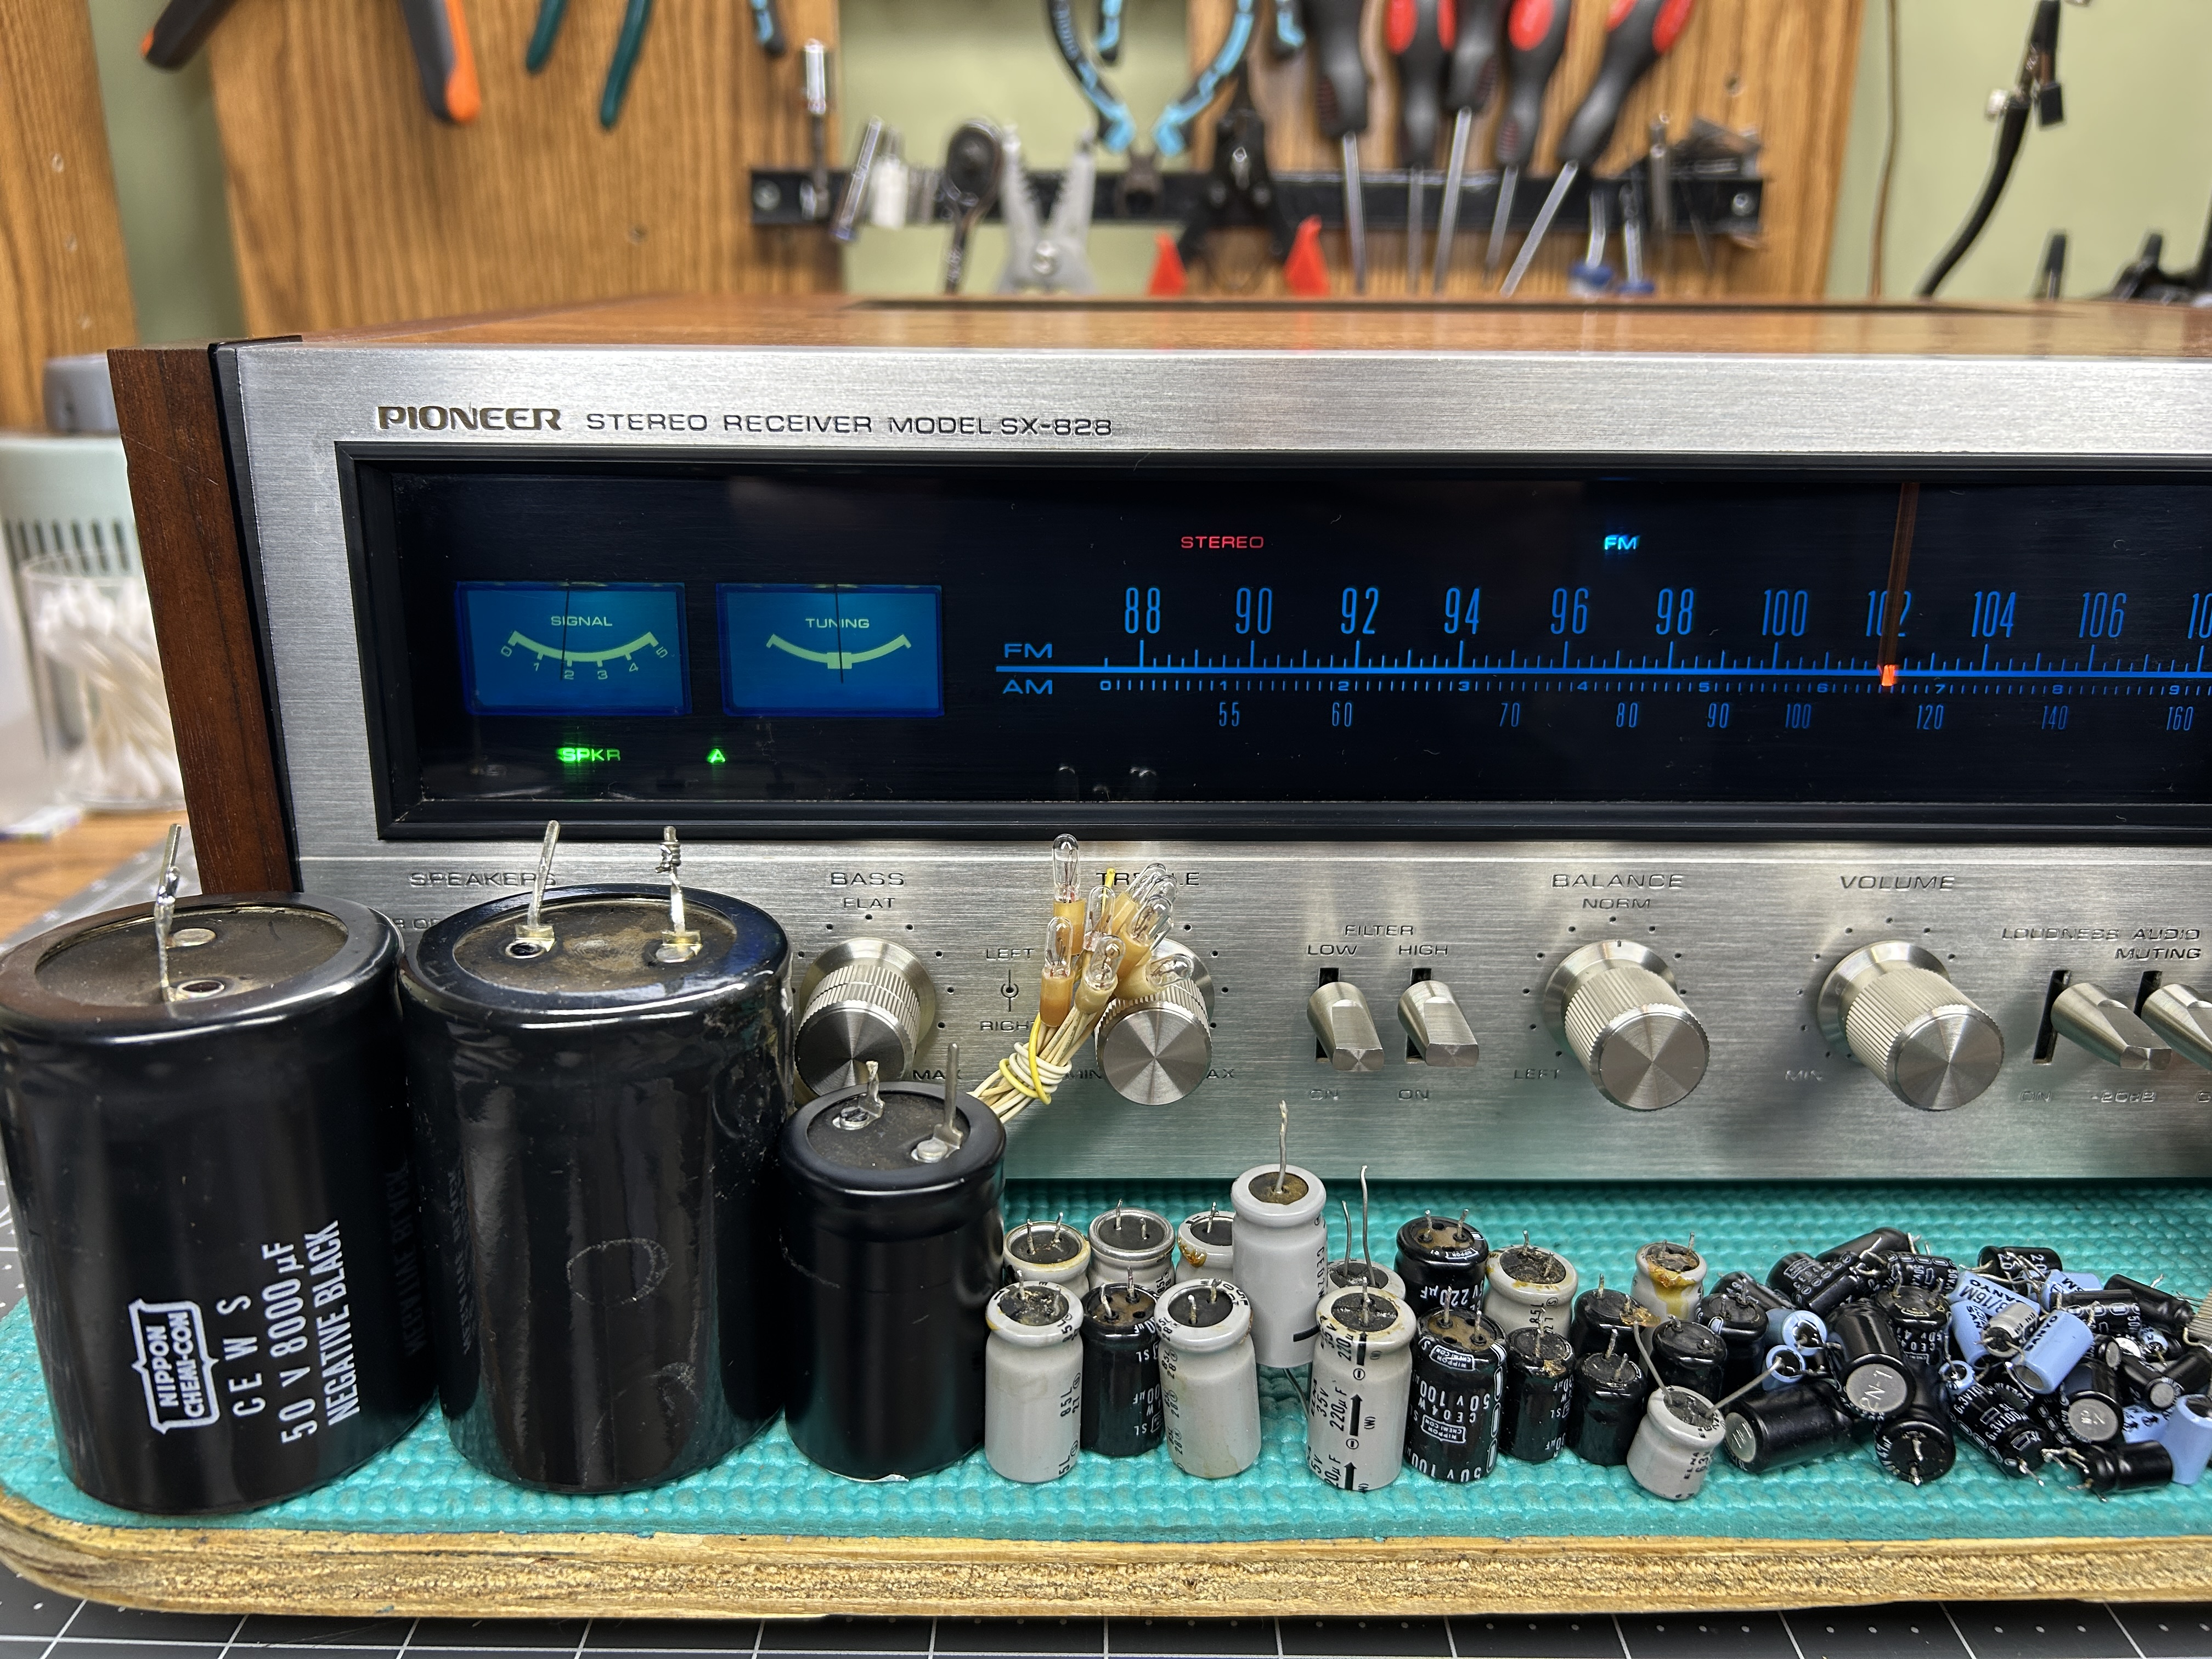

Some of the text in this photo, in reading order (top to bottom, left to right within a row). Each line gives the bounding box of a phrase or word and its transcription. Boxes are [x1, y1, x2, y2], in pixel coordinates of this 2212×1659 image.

[377, 406, 562, 431] PIONEER
[587, 413, 1113, 437] STEREO RECEIVER MODEL SX-828
[1181, 535, 1264, 549] STEREO
[1604, 534, 1640, 550] FM
[1124, 586, 1160, 634] 88
[1235, 587, 1272, 634] 90
[1340, 587, 1379, 634] 92
[1443, 587, 1480, 635] 94
[1550, 588, 1589, 635] 96
[1655, 588, 1695, 635] 98
[1762, 589, 1809, 636] 100
[1971, 591, 2016, 638] 104
[2078, 591, 2127, 638] 106
[2187, 592, 2212, 639] 10
[550, 615, 613, 627] SIGNAL
[805, 618, 870, 629] TUNING
[1004, 643, 1053, 658] FM
[533, 662, 540, 672] 1
[564, 670, 574, 680] 2
[597, 670, 608, 680] 3
[629, 662, 639, 672] 4
[1002, 679, 1053, 695] AM
[1219, 680, 1227, 691] 1
[1338, 680, 1350, 691] 2
[1458, 680, 1470, 691] 3
[1577, 681, 1588, 691] 4
[1698, 682, 1710, 693] 5
[1816, 682, 1829, 693] 6
[1934, 684, 1946, 695] 7
[2052, 685, 2063, 695] 8
[2168, 685, 2180, 695] 9
[1218, 701, 2193, 731] 55 60 70 80 90 100 120 140 160
[560, 747, 621, 761] SPKR
[708, 748, 726, 763] A
[831, 872, 904, 887] BASS
[1096, 872, 1200, 886] TRE
[1551, 874, 1684, 889] BALANCE
[1840, 875, 1955, 891] VOLUME
[843, 898, 896, 910] FLAT
[1582, 898, 1651, 910] NORM
[1344, 924, 1414, 936] FILTER
[2001, 928, 2120, 941] LOUDNESS
[2132, 928, 2201, 941] AUDIO
[986, 948, 1035, 960] LEFT
[1307, 944, 1358, 956] LOW
[1398, 944, 1449, 956] HIGH
[2115, 947, 2202, 961] MUTING
[1206, 1068, 1234, 1079] AX
[1514, 1069, 1562, 1080] LEFT
[1308, 1089, 1339, 1101] ON
[1398, 1089, 1430, 1101] ON
[2019, 1091, 2052, 1103] ON
[303, 1220, 360, 1426] NEGATIVE BLACK
[144, 1325, 179, 1408] NIPPON
[167, 1312, 205, 1419] CHEMI-CON
[1060, 1386, 1073, 1418] 85L
[1316, 1387, 1329, 1418] 35V
[1058, 1454, 1070, 1476] 5L
[1311, 1454, 1323, 1474] 5V
[1683, 1452, 1700, 1480] ELNA
